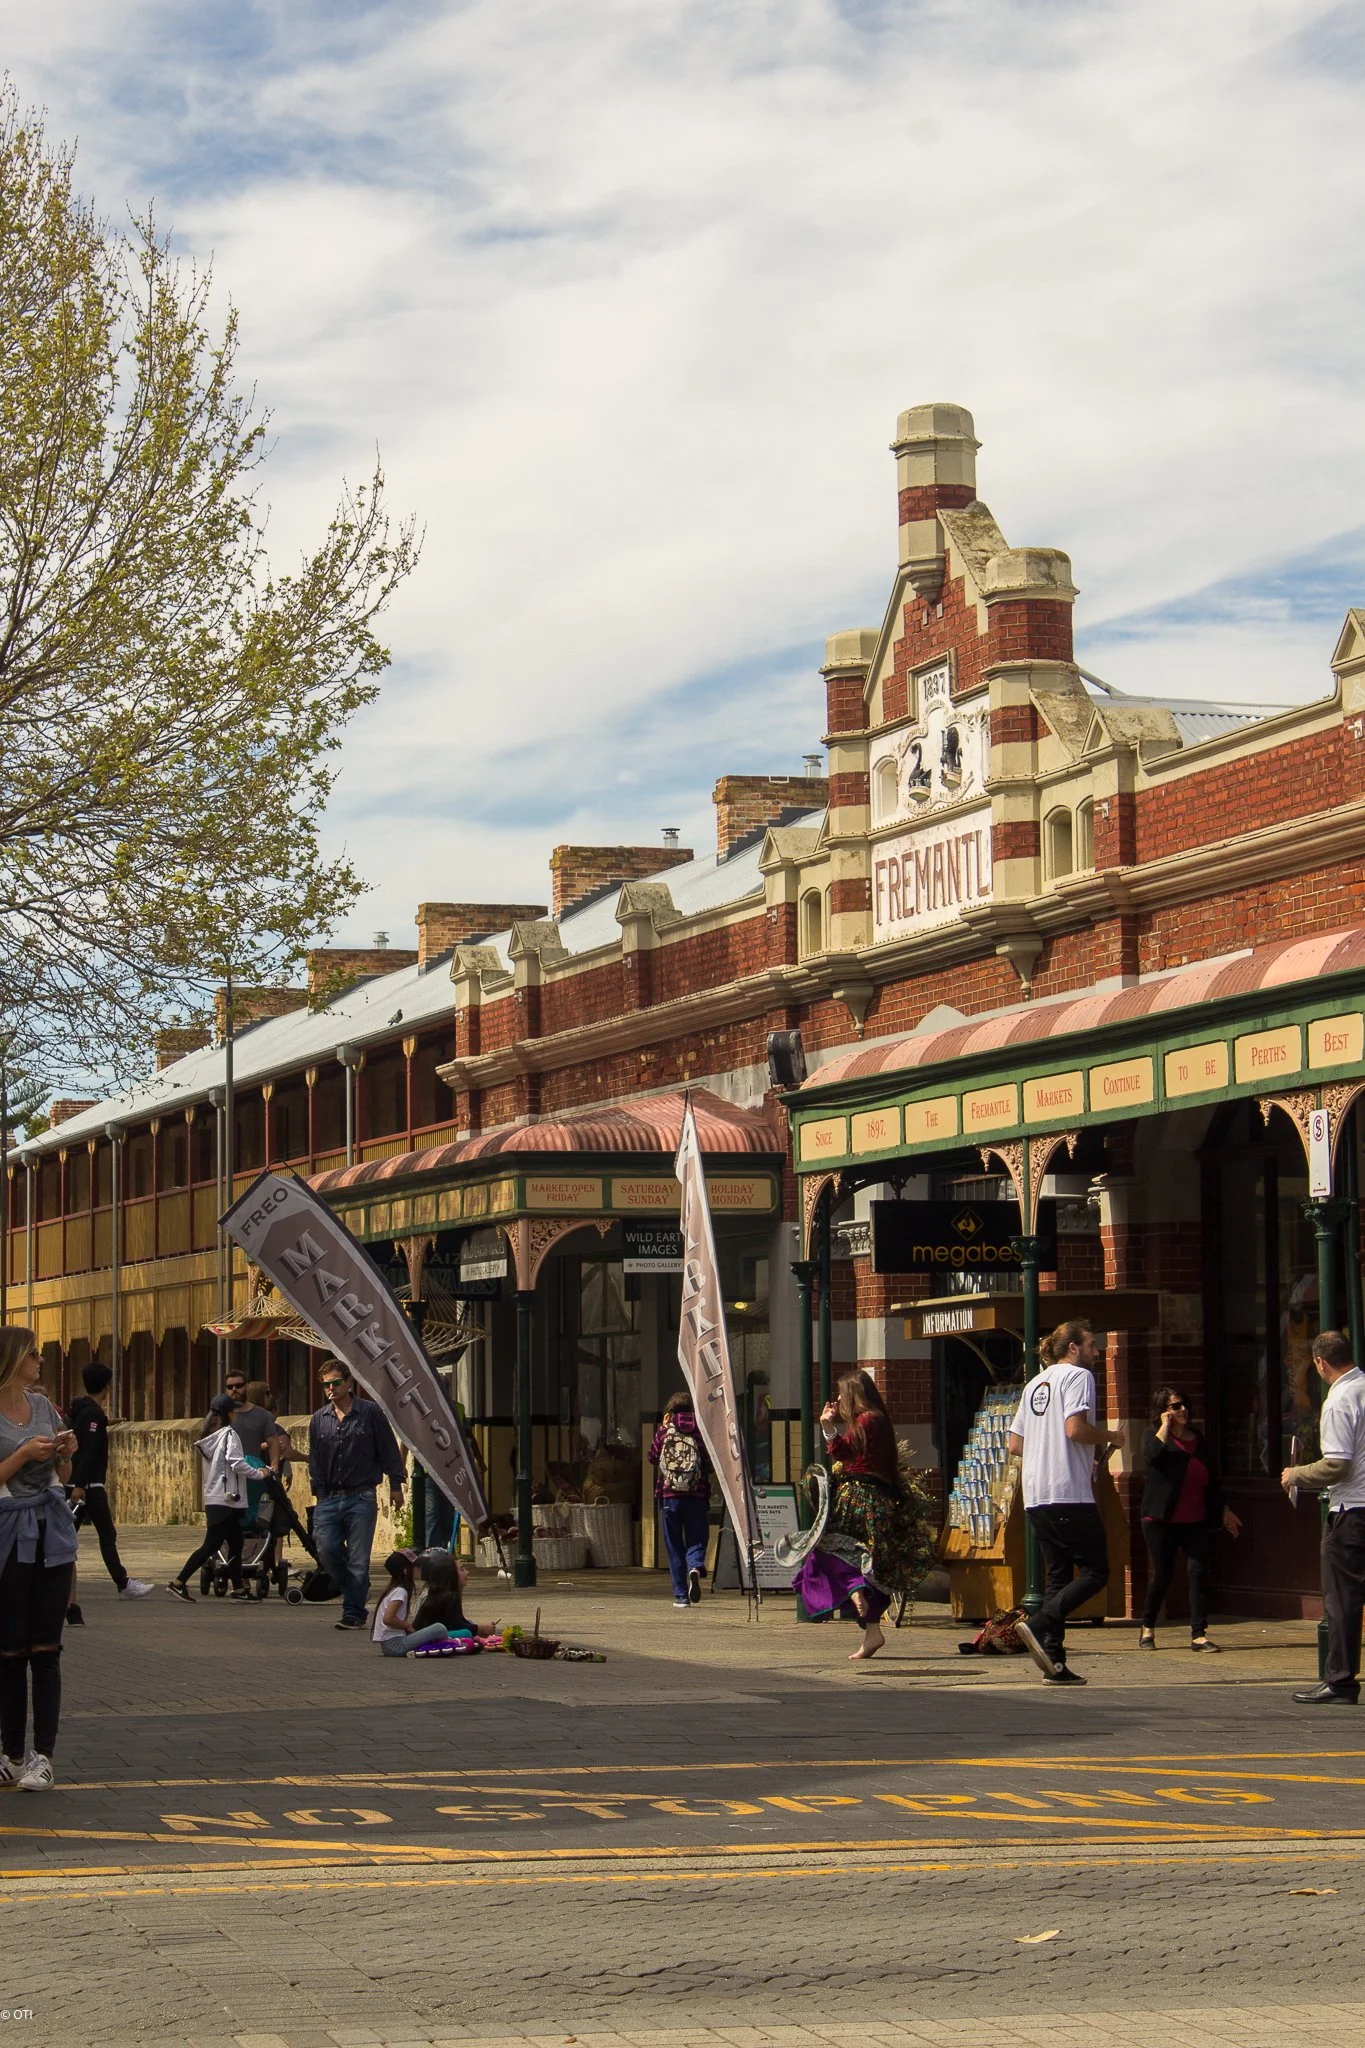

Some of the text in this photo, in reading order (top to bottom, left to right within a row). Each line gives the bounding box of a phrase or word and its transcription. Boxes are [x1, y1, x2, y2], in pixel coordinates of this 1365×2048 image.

[923, 672, 946, 700] 1897
[875, 830, 994, 926] FREMANTL
[1178, 1065, 1188, 1080] TO
[1205, 1059, 1216, 1075] BE
[531, 1184, 595, 1193] MARKET OPEN
[620, 1183, 677, 1194] SATURDAY
[711, 1183, 755, 1194] HOLIDAY
[547, 1192, 580, 1202] FRIDAY
[628, 1194, 669, 1205] SUNDAY
[711, 1194, 755, 1205] MONDAY
[240, 1187, 289, 1237] FREO
[625, 1232, 685, 1243] WILD EART
[638, 1244, 678, 1255] IMAGES
[922, 1307, 973, 1335] INFORMATION
[277, 1228, 452, 1450] MARKETS
[160, 1786, 1276, 1832] NO STOPPING
